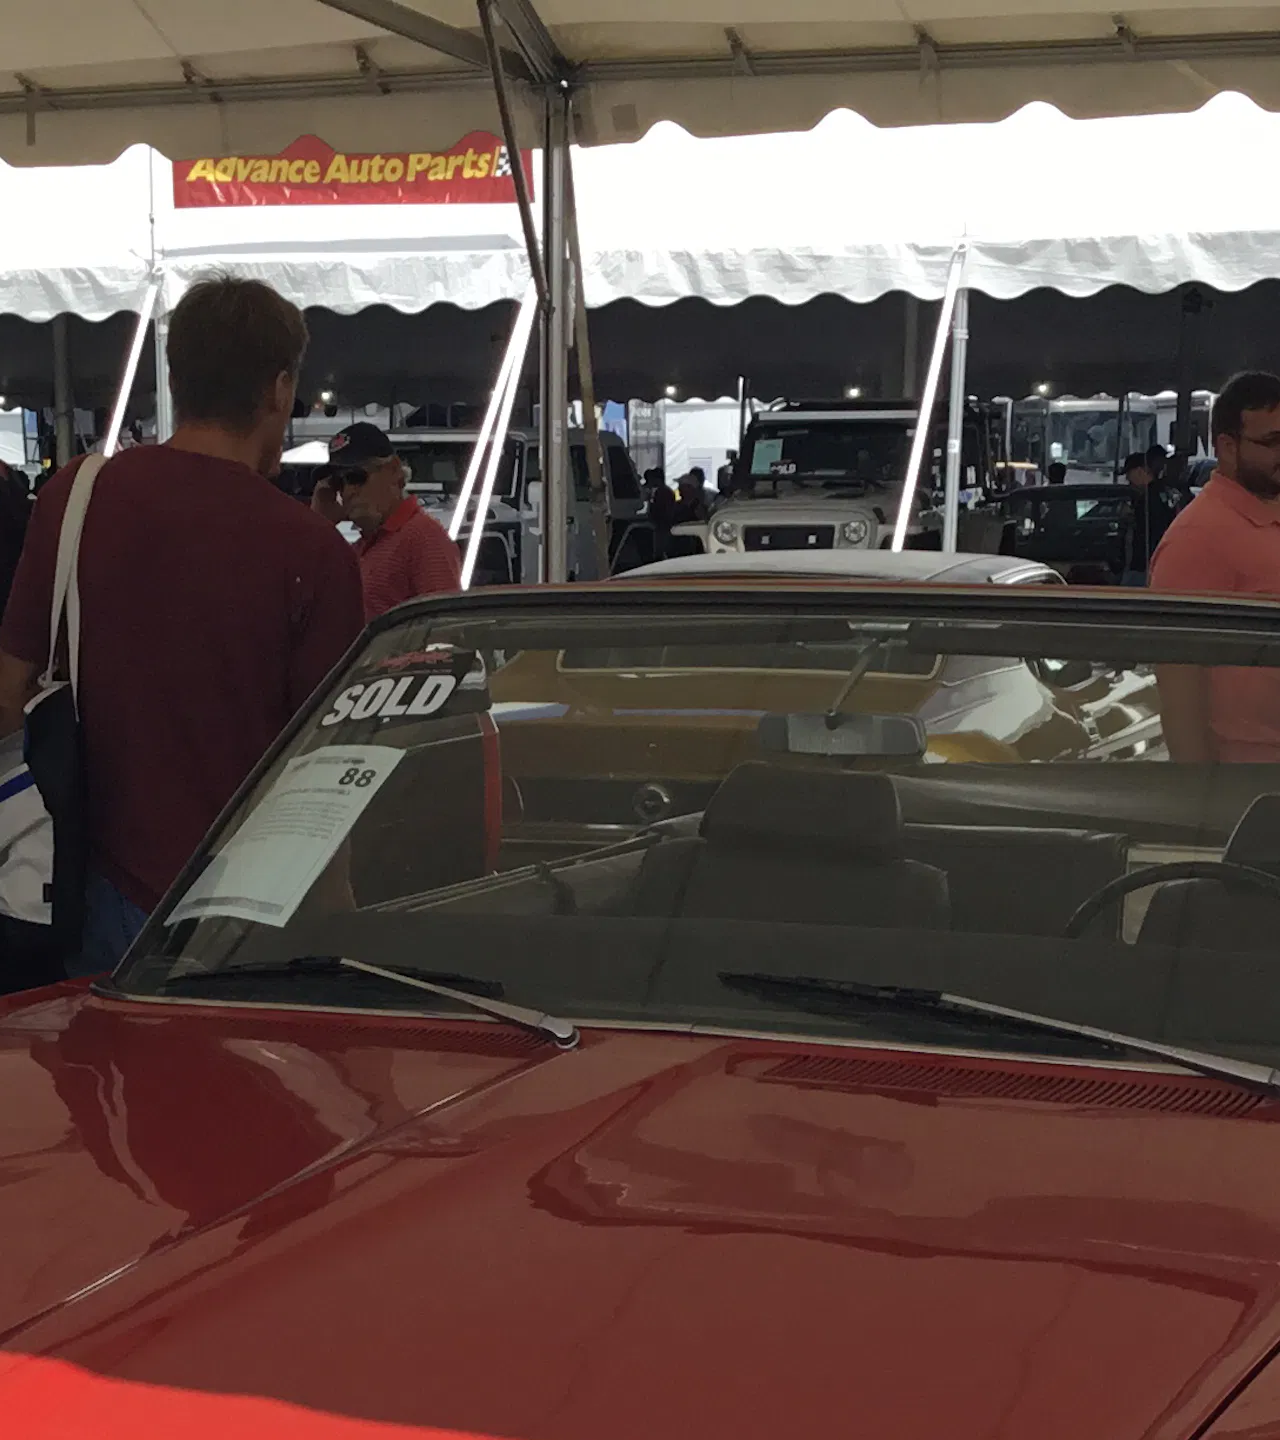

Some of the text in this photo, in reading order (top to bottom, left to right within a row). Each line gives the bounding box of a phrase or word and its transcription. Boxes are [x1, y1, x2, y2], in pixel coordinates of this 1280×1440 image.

[186, 148, 491, 184] Advance Auto Parts
[321, 674, 457, 726] SOLD
[338, 767, 377, 788] 88
